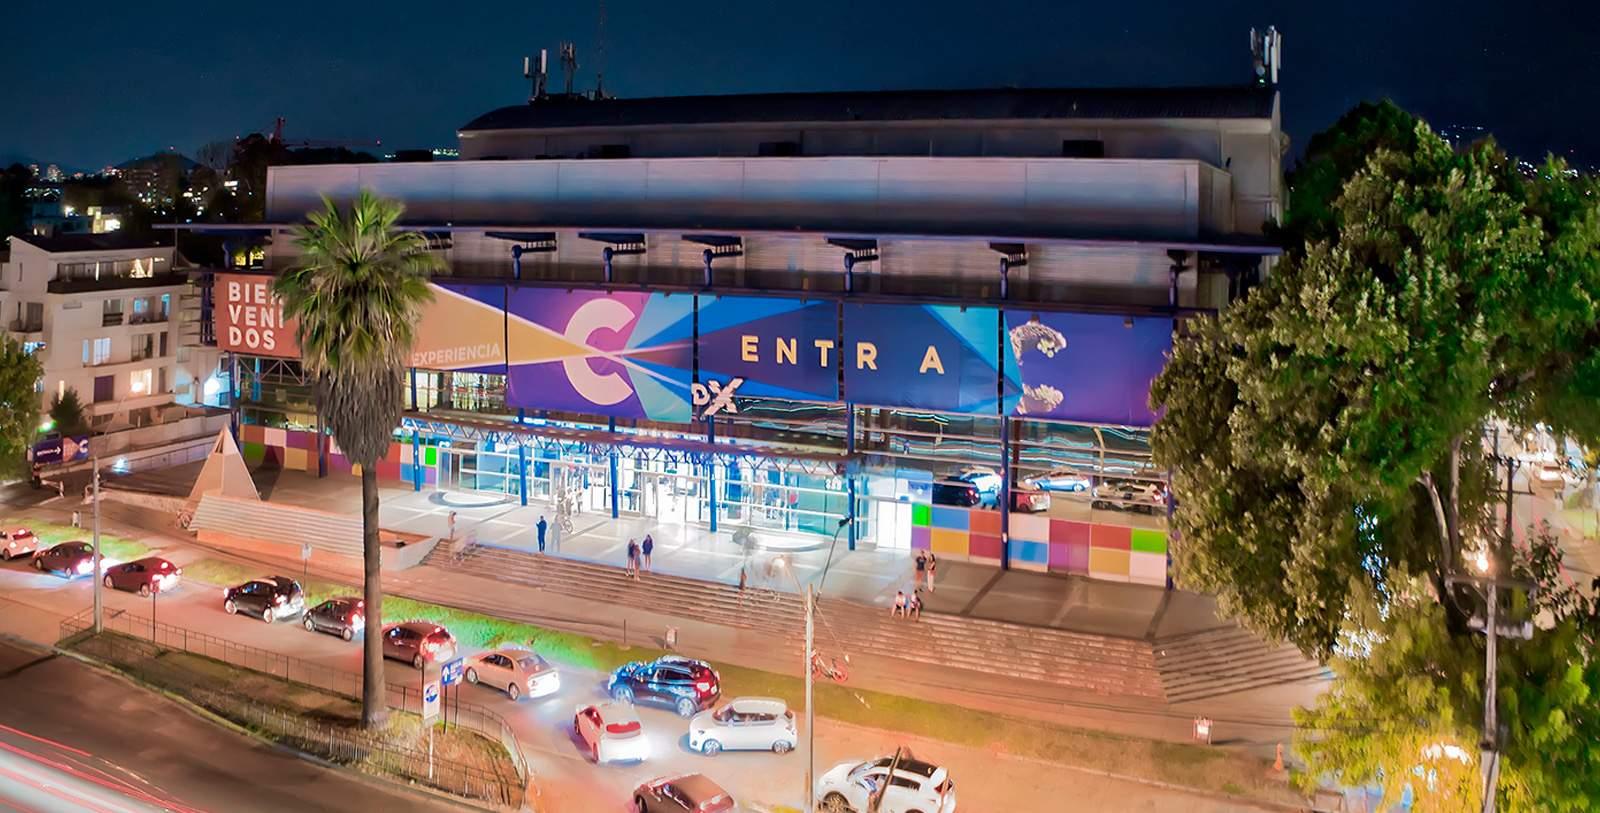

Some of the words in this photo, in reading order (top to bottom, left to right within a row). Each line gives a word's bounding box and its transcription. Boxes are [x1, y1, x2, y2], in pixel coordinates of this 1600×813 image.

[228, 281, 284, 305] BIE
[228, 304, 284, 329] VENI
[228, 326, 276, 351] DOS
[412, 343, 501, 366] EXPERIENCIA
[741, 334, 945, 375] ENTRA
